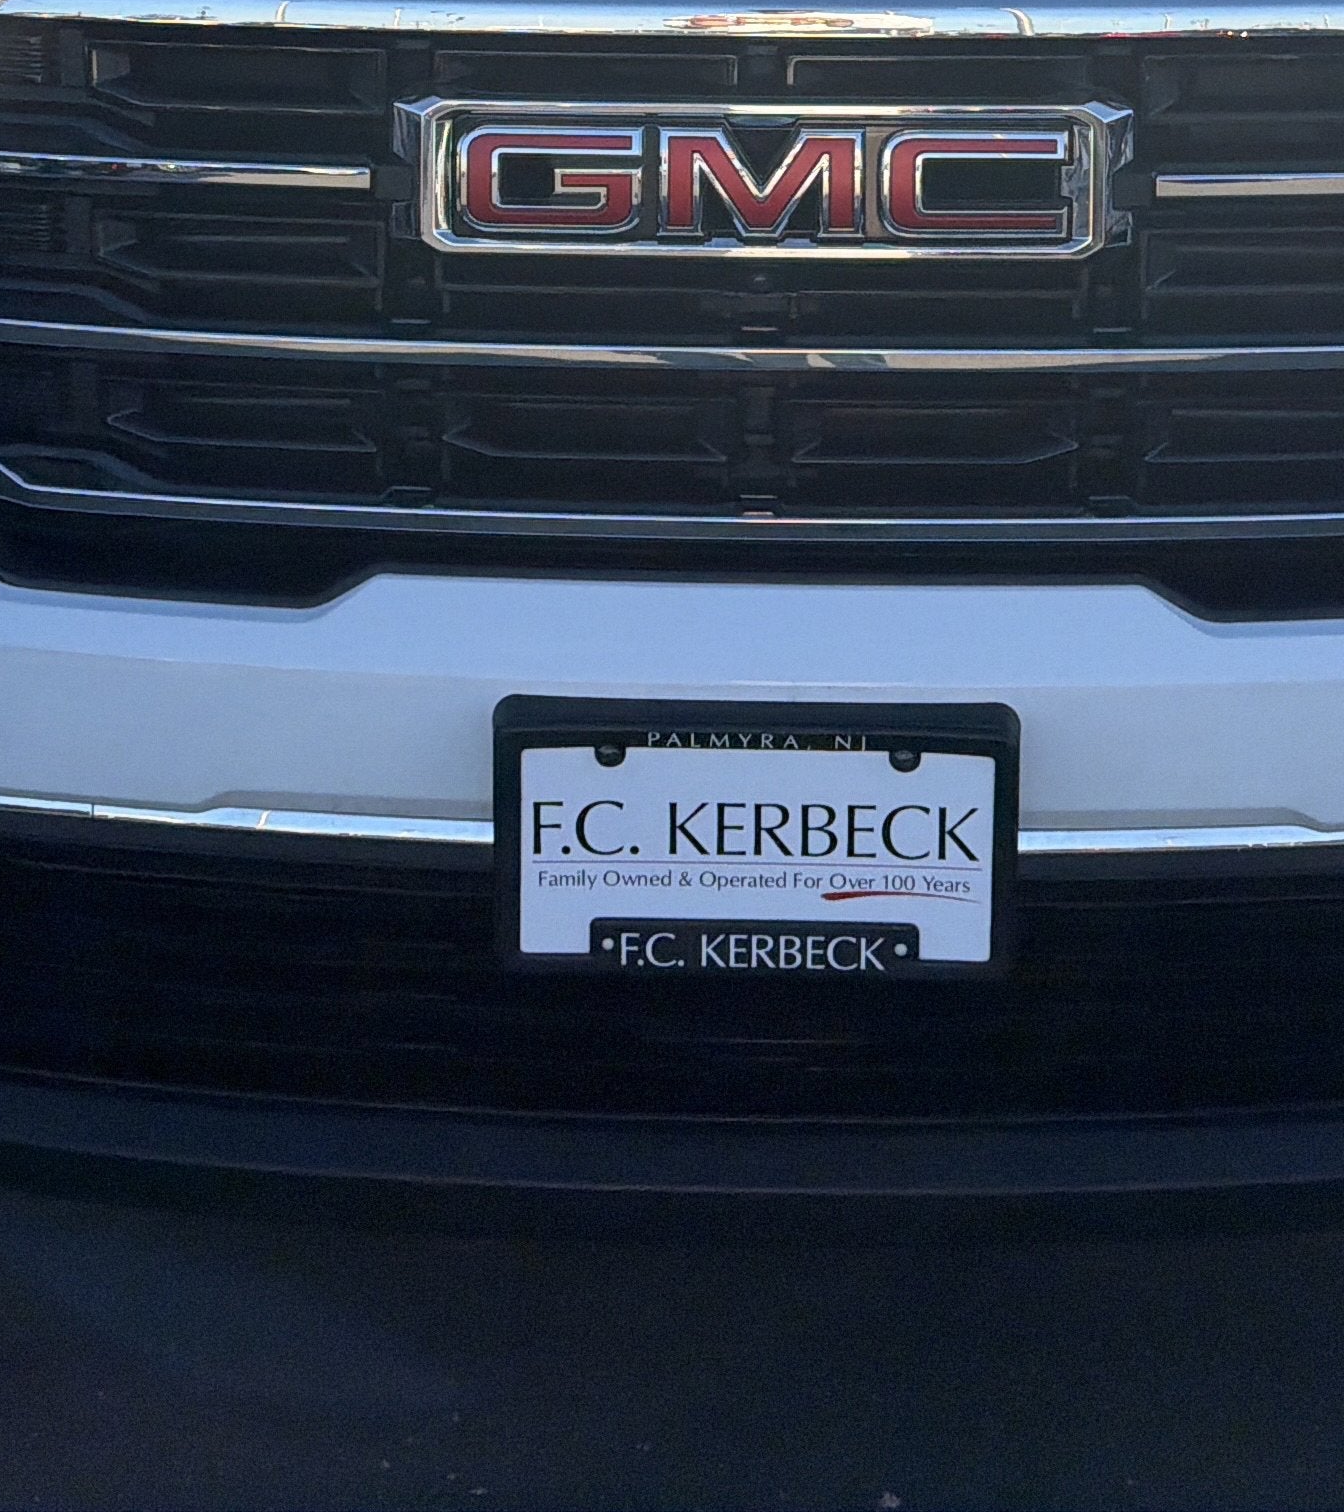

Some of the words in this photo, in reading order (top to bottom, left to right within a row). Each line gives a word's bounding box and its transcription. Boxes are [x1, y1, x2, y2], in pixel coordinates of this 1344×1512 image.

[456, 123, 1069, 239] GMC
[532, 800, 640, 855] F.C.
[668, 802, 980, 862] KERBECK
[538, 869, 598, 890] Family
[603, 869, 672, 887] Owned
[678, 870, 692, 887] &
[699, 870, 787, 891] Operated
[793, 872, 823, 888] For
[829, 873, 876, 890] Over
[882, 875, 916, 891] 100
[922, 875, 971, 892] Years
[620, 932, 685, 967] F.C.
[701, 934, 886, 971] KERBECK
